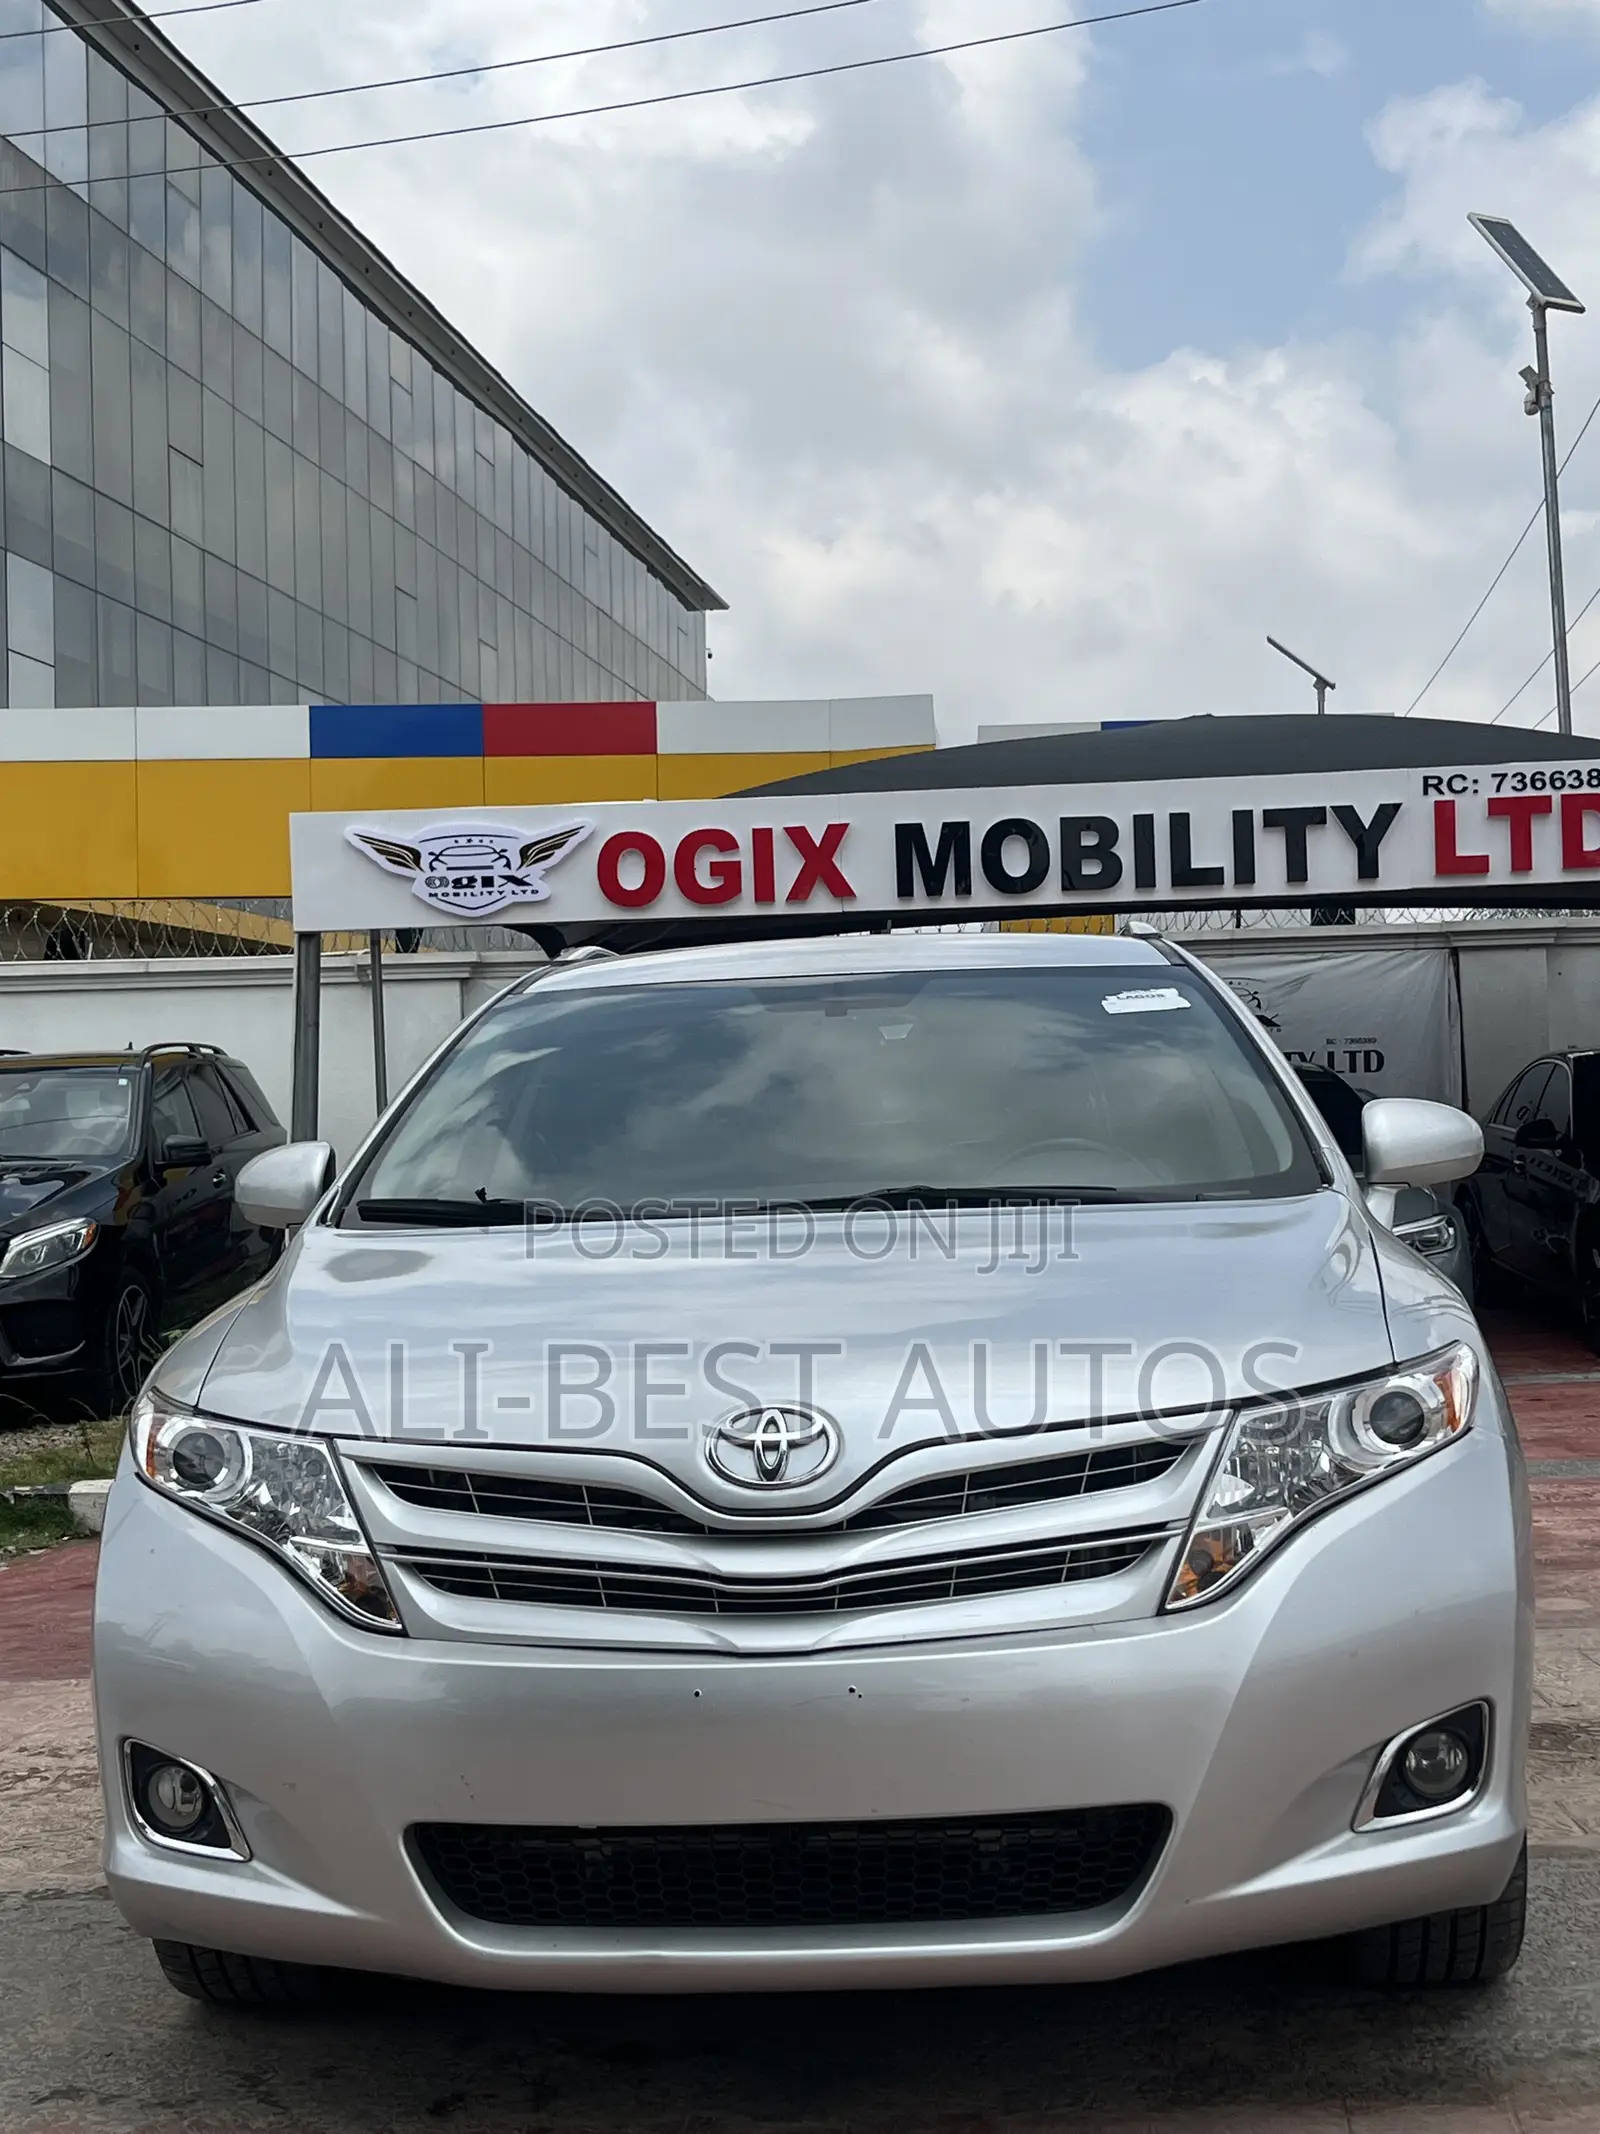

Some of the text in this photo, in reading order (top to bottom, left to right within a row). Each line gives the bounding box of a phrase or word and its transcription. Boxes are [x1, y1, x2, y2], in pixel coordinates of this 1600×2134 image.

[1422, 774, 1479, 796] RC:
[597, 793, 1600, 909] OGIX MOBILITY LTD
[1327, 1049, 1385, 1073] LTD
